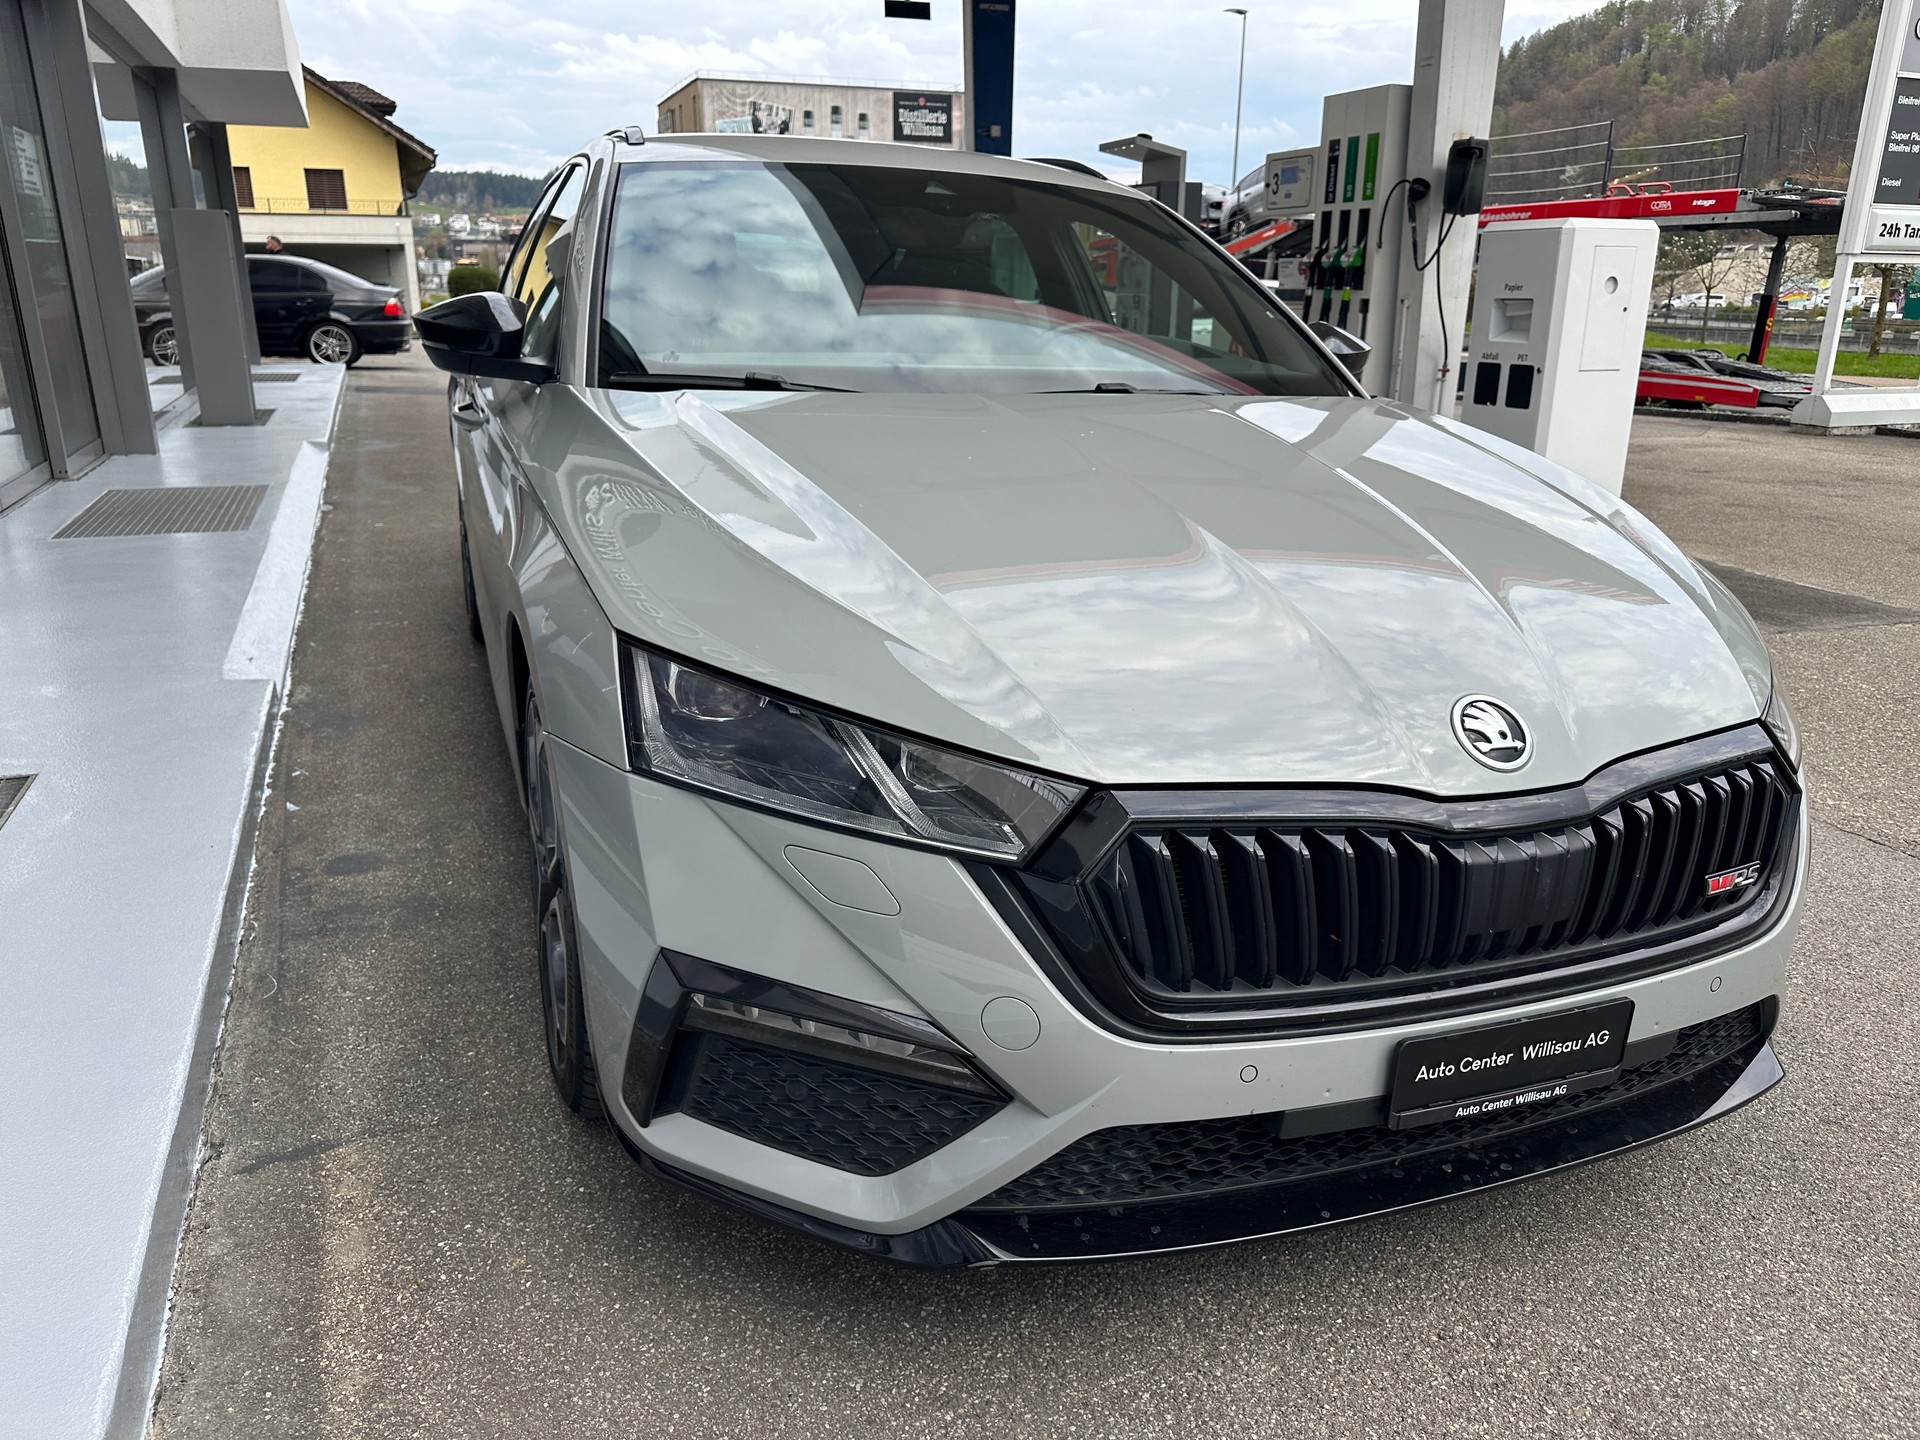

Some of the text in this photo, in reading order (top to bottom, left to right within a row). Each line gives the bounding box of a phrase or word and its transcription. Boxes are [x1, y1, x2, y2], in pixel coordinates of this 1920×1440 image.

[1890, 130, 1911, 142] Super
[1888, 142, 1920, 153] Bleifrei 98
[1271, 172, 1280, 195] 3
[1881, 177, 1902, 187] Diesel
[1879, 222, 1902, 238] 24h
[1504, 283, 1523, 293] Papier
[1482, 352, 1499, 361] Abfall
[1517, 353, 1529, 362] PET
[1414, 1029, 1610, 1082] Auto Center Willisau AG
[1455, 1084, 1568, 1118] Auto Center Willisau AG
